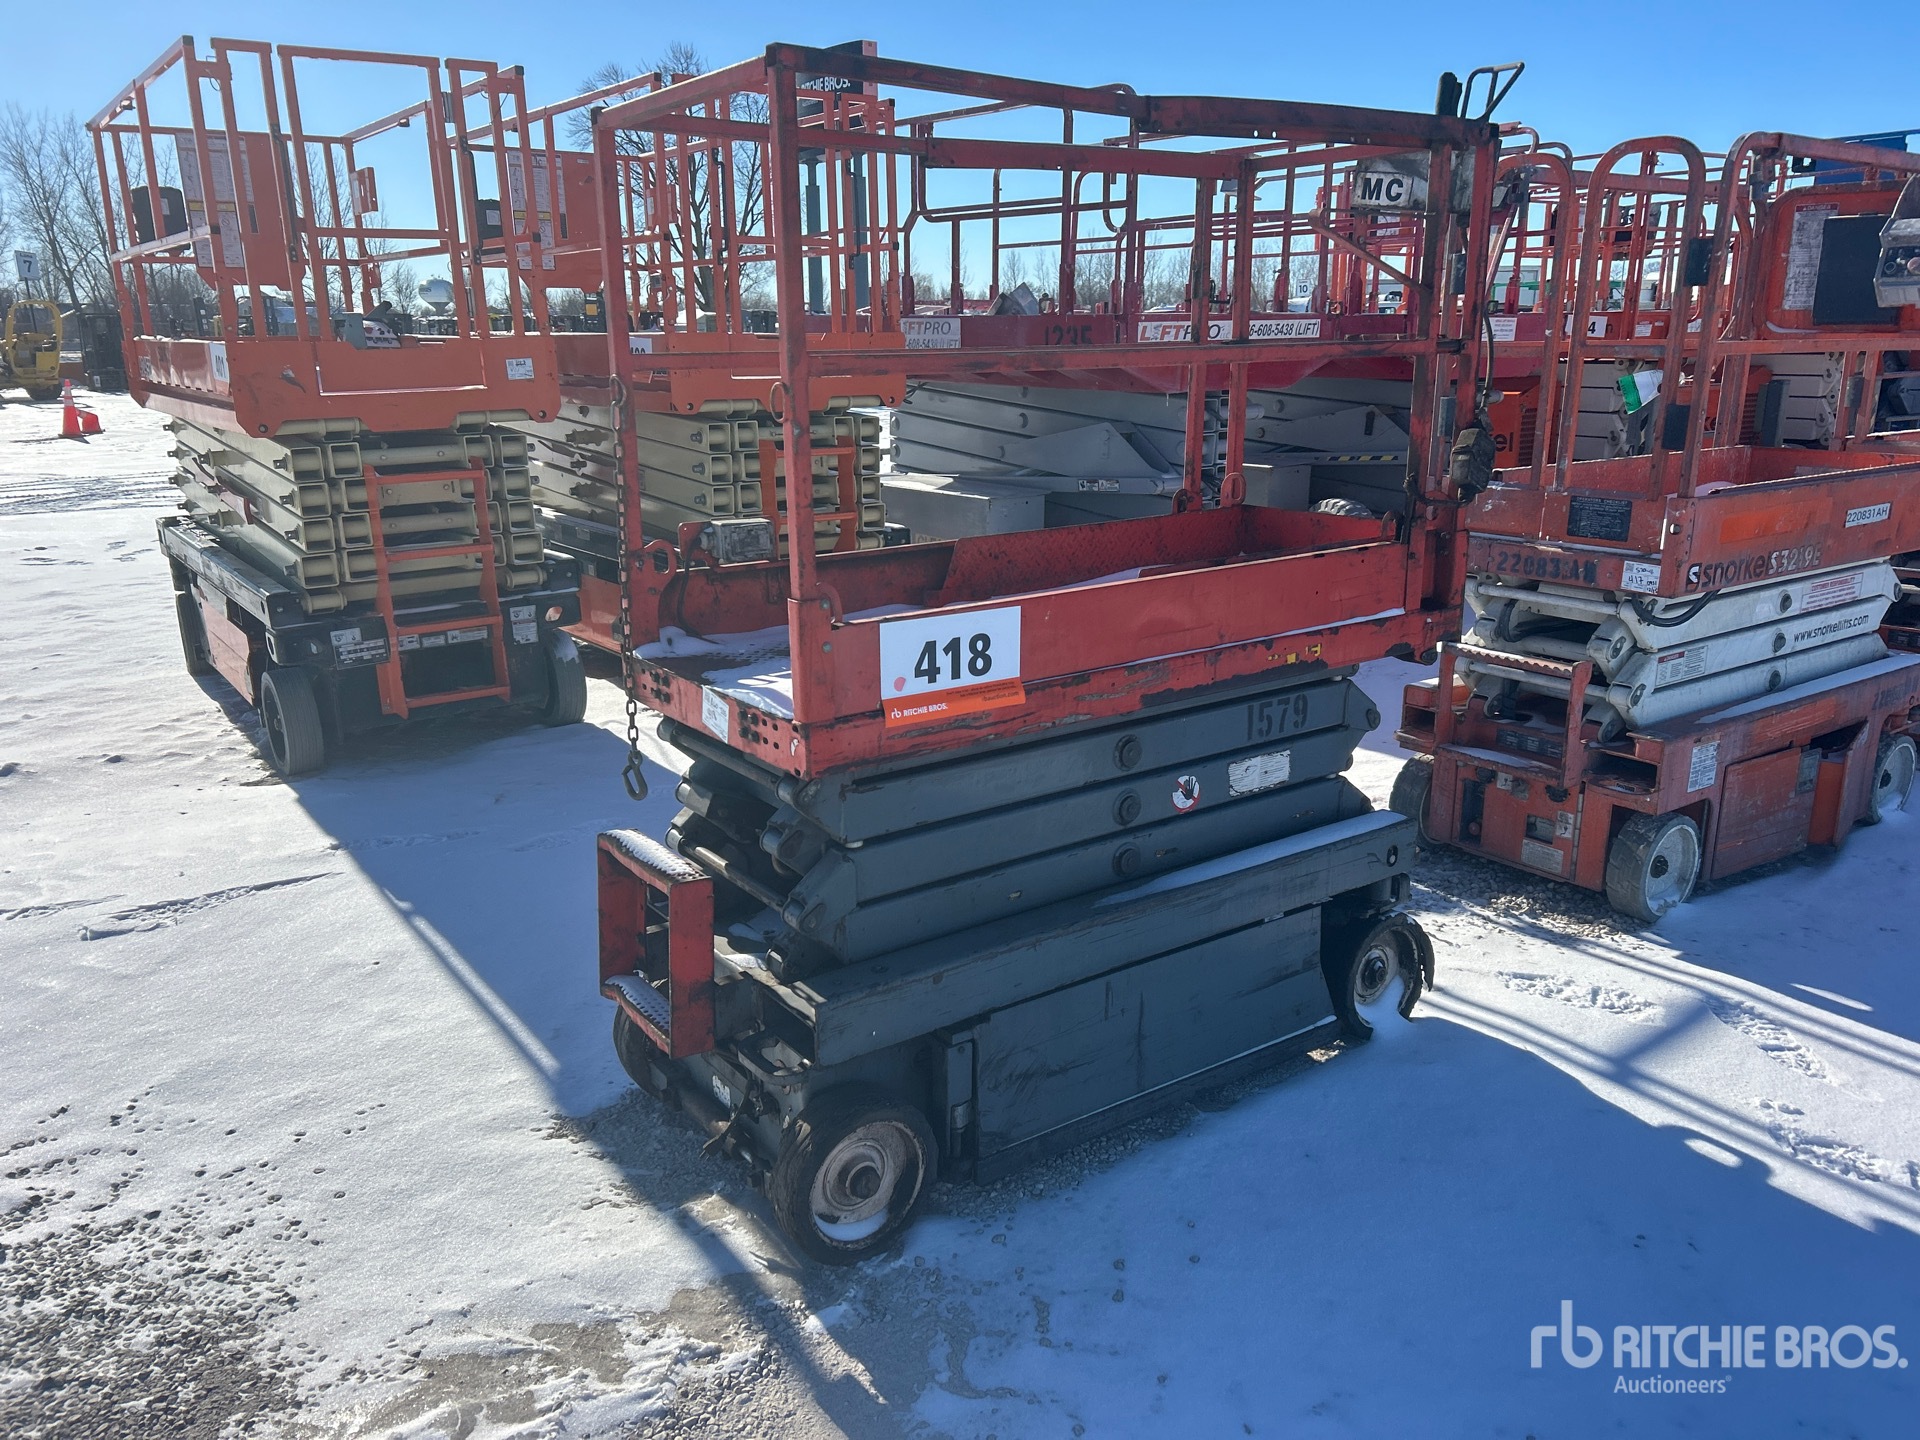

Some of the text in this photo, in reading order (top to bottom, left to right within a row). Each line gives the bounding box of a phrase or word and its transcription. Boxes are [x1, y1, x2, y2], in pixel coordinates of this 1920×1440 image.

[1361, 177, 1404, 202] MC
[22, 259, 33, 273] 7
[1298, 284, 1309, 294] 10
[1249, 321, 1320, 338] 6-608-5438 (LIFT)
[1847, 506, 1889, 524] 220831AH
[1700, 552, 1773, 588] snorkel
[1793, 614, 1869, 642] www.snorkellifts.com
[914, 633, 992, 684] 418
[903, 704, 928, 717] RITCHIE
[928, 702, 948, 712] BROS.
[1247, 693, 1309, 741] 1579
